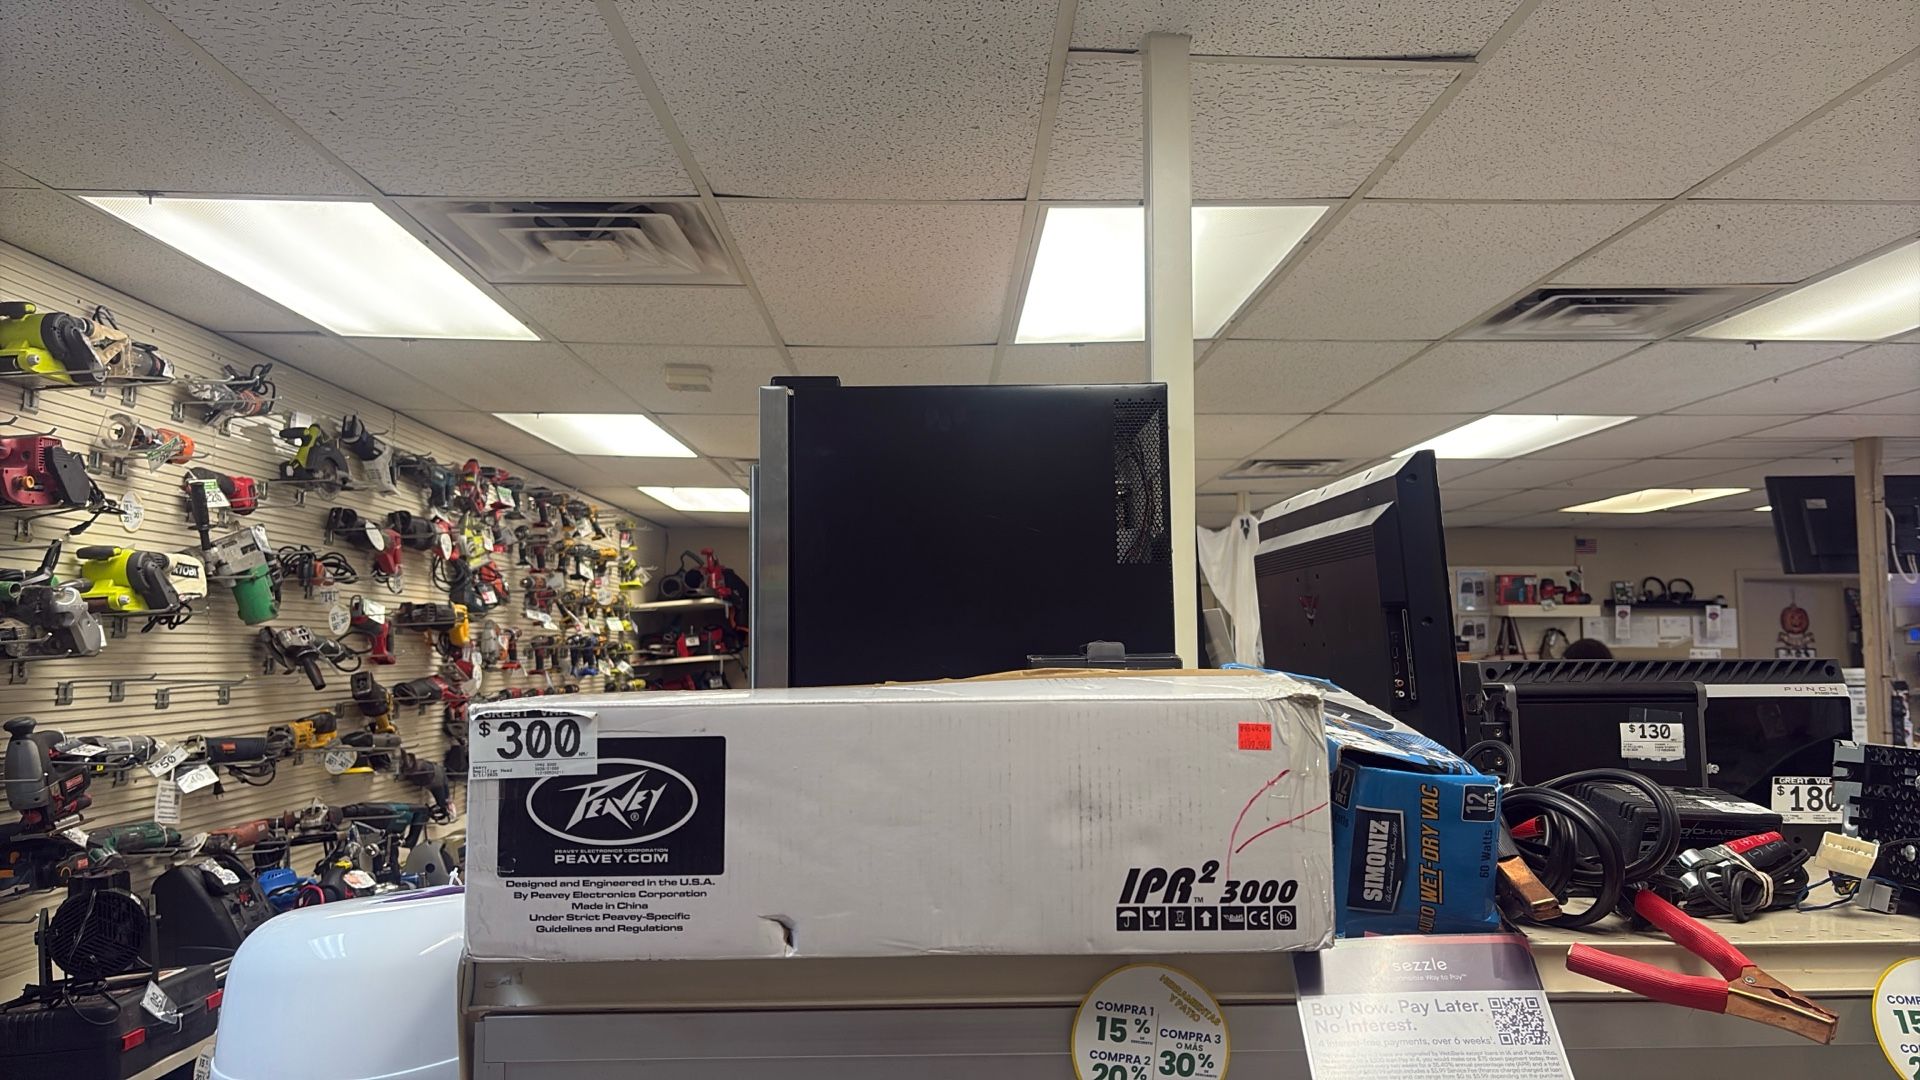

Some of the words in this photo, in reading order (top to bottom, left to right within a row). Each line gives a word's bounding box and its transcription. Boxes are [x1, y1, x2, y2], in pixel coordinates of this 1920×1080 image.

[1420, 784, 1440, 821] VAC
[1466, 793, 1487, 814] 12
[1481, 830, 1493, 863] Watts
[554, 854, 669, 864] PEAVEY.COM
[1363, 819, 1389, 902] SIMONIZ
[1480, 866, 1489, 878] 60
[505, 880, 557, 889] Designed
[582, 879, 645, 888] Engineered
[679, 878, 715, 886] U.S.A.
[514, 892, 528, 900] By
[530, 892, 570, 900] Peavey
[638, 890, 707, 899] Corporation
[1219, 879, 1298, 904] 3000
[571, 902, 603, 910] Made
[566, 913, 600, 921] Strict
[602, 912, 690, 922] Peavey-Specific
[535, 925, 592, 933] Guidelines
[594, 924, 615, 932] and
[617, 924, 683, 934] Regulations
[1392, 957, 1447, 971] sezzle
[1096, 1000, 1147, 1016] COMPRA
[1149, 1006, 1154, 1017] 1
[1311, 1002, 1343, 1019] Buy
[1349, 1001, 1393, 1015] Now.
[1398, 999, 1429, 1017] Pay
[1434, 998, 1484, 1013] Later.
[1315, 1020, 1340, 1034] No
[1346, 1019, 1417, 1033] Interest.
[1160, 1028, 1212, 1044] COMPRA
[1214, 1034, 1222, 1044] 3
[1454, 1036, 1461, 1045] 6
[1176, 1042, 1183, 1050] O
[1184, 1042, 1203, 1052] MÁS
[1900, 1043, 1920, 1054] CO
[1090, 1050, 1141, 1065] COMPRA
[1144, 1056, 1152, 1066] 2
